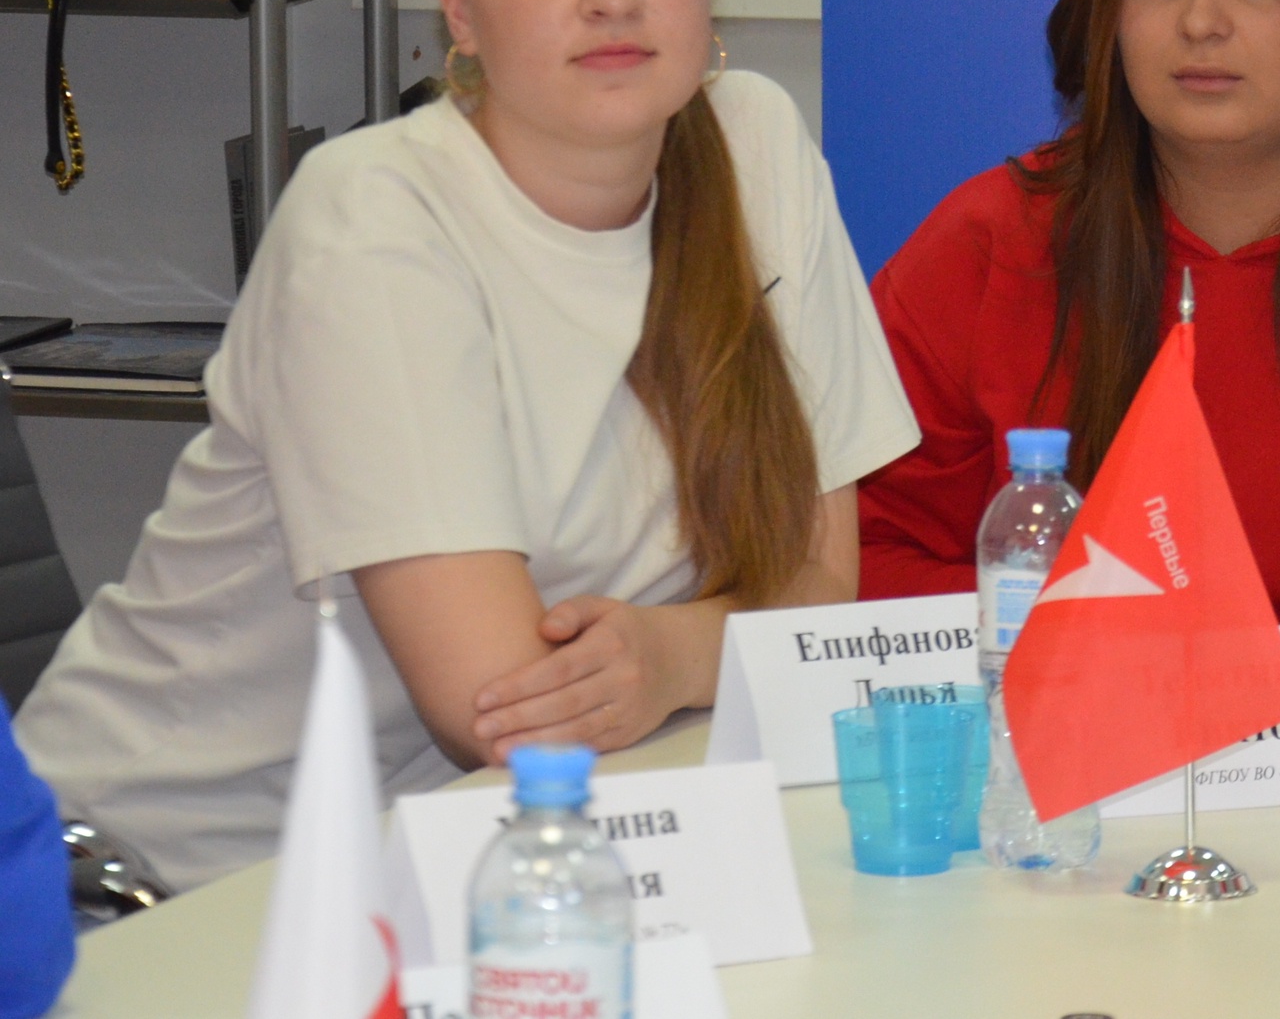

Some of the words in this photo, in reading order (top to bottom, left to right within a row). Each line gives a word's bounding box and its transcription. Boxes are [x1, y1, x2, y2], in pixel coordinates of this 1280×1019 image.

[1143, 495, 1190, 589] Первые
[1194, 768, 1250, 785] ФГБОУ
[1254, 765, 1276, 781] ВО
